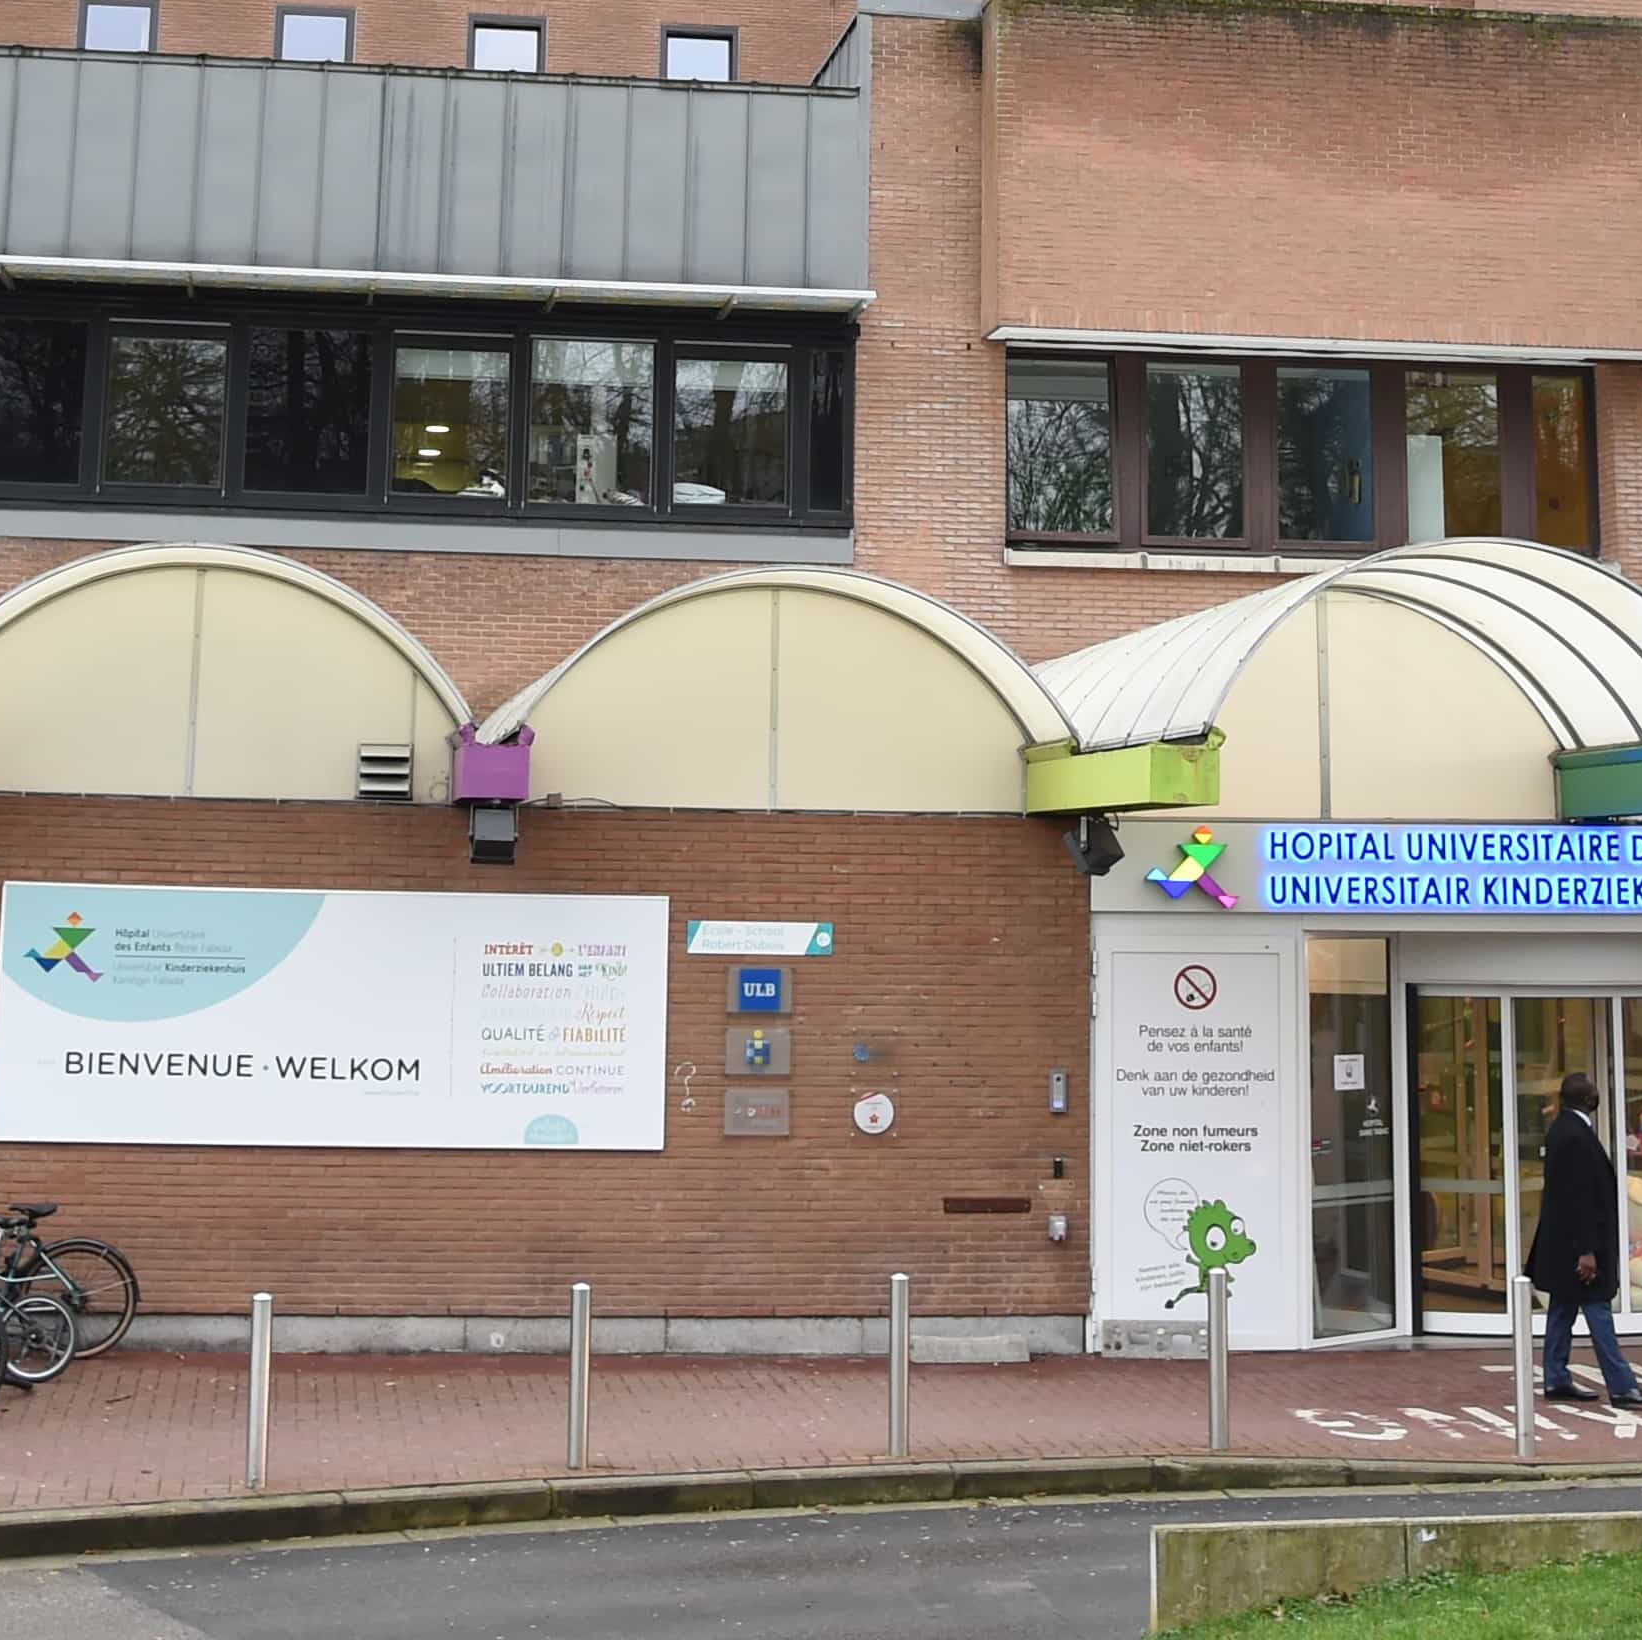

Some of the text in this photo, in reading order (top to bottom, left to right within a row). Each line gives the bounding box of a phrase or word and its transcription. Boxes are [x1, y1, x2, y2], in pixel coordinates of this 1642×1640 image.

[1270, 831, 1395, 860] HOPITAL
[1407, 832, 1620, 861] UNIVERSITAIRE
[1271, 875, 1470, 905] UNIVERSITAIR
[115, 928, 150, 939] Hôpital
[115, 942, 131, 951] des
[135, 942, 171, 952] Enfants
[484, 942, 534, 956] INTÉRÊT
[482, 963, 525, 977] ULTIEM
[528, 963, 573, 977] BELANG
[481, 983, 572, 1000] Collaboration
[743, 982, 776, 997] ULB
[481, 1024, 545, 1042] QUALITÉ
[563, 1024, 626, 1042] FIABILITÉ
[1139, 1024, 1185, 1038] Pensez
[1203, 1024, 1213, 1038] la
[1218, 1024, 1252, 1038] santé
[1147, 1040, 1243, 1052] de vos enfants!
[65, 1051, 421, 1081] BIENVENUE WELKOM
[556, 1065, 625, 1076] CONTINUE
[1116, 1069, 1275, 1085] Denk aan de gezondheid
[1142, 1085, 1249, 1096] van uw kinderen!
[1133, 1124, 1259, 1137] Zone non fumeurs
[1140, 1139, 1252, 1152] Zone niet-rokers
